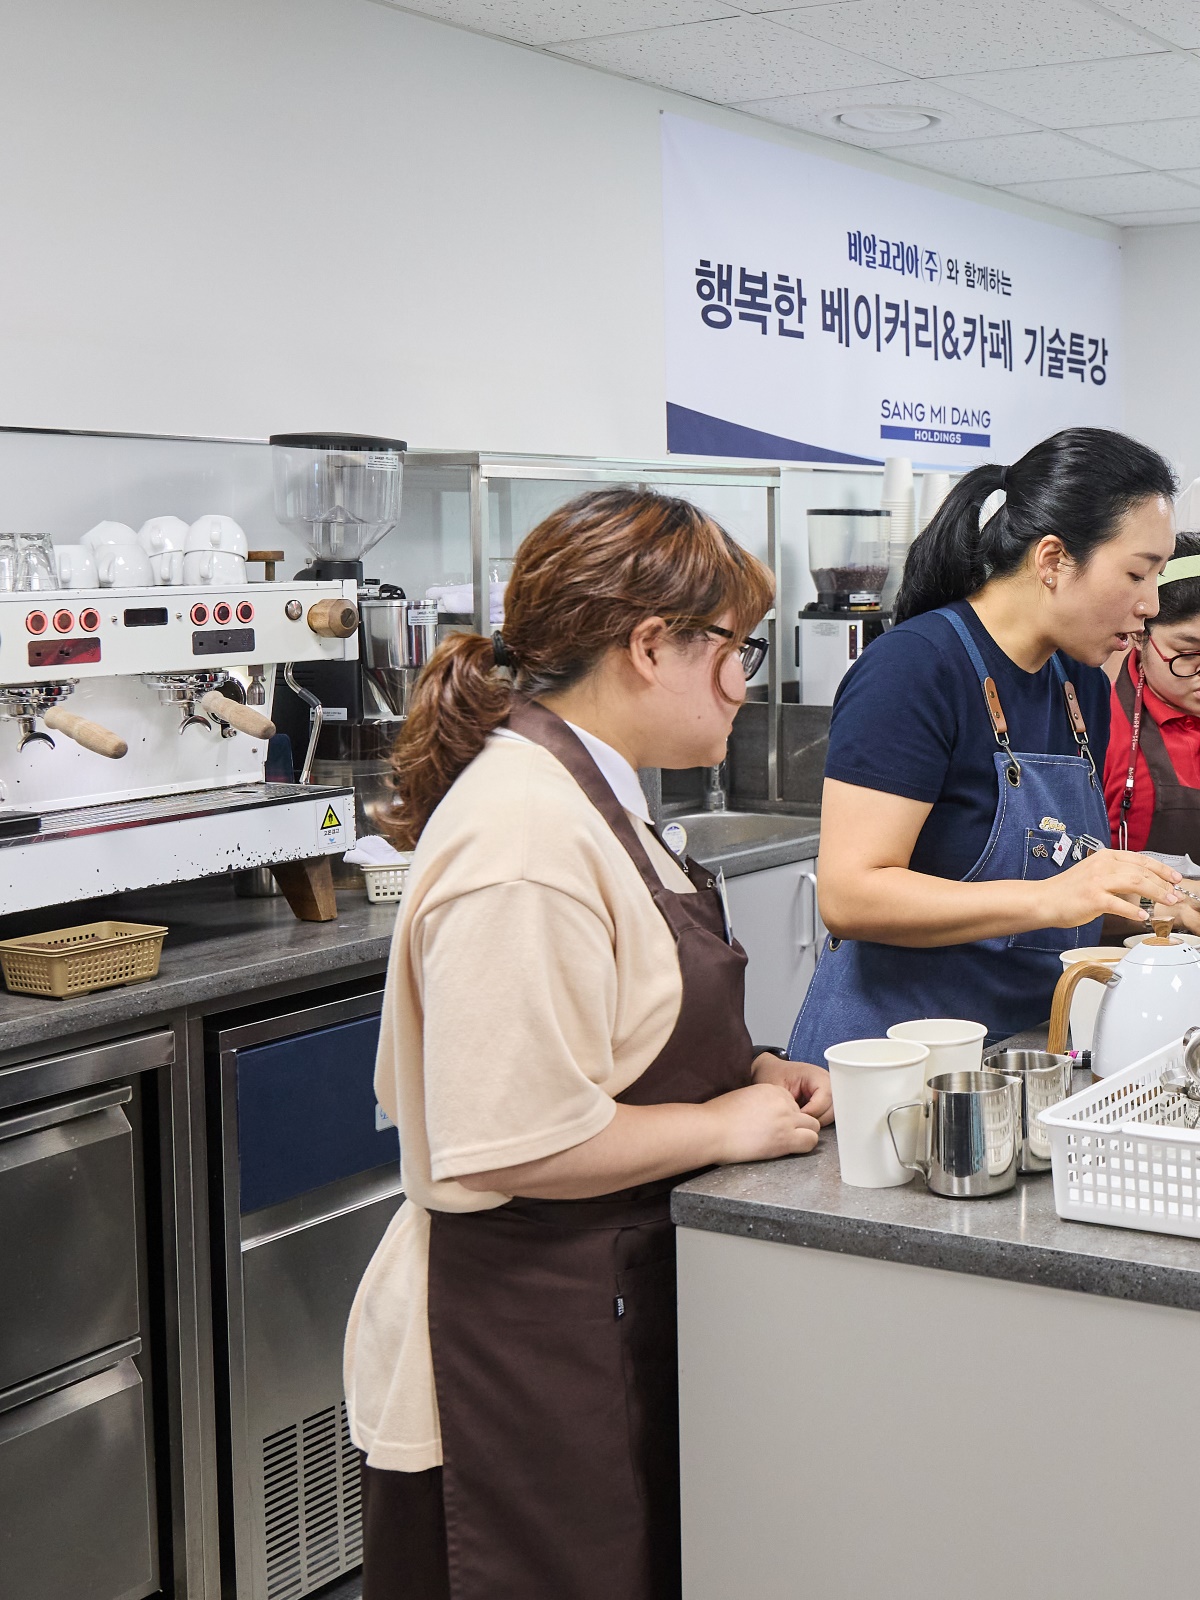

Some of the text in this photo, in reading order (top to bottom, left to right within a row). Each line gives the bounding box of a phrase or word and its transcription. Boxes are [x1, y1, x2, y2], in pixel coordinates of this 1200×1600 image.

[847, 230, 1012, 297] 비알코리아(주) 와 함께하는
[695, 258, 1109, 387] 행복한 베이커리&카페 기술특강
[880, 399, 991, 429] SANG MI DANG
[914, 429, 962, 444] HOLDINGS
